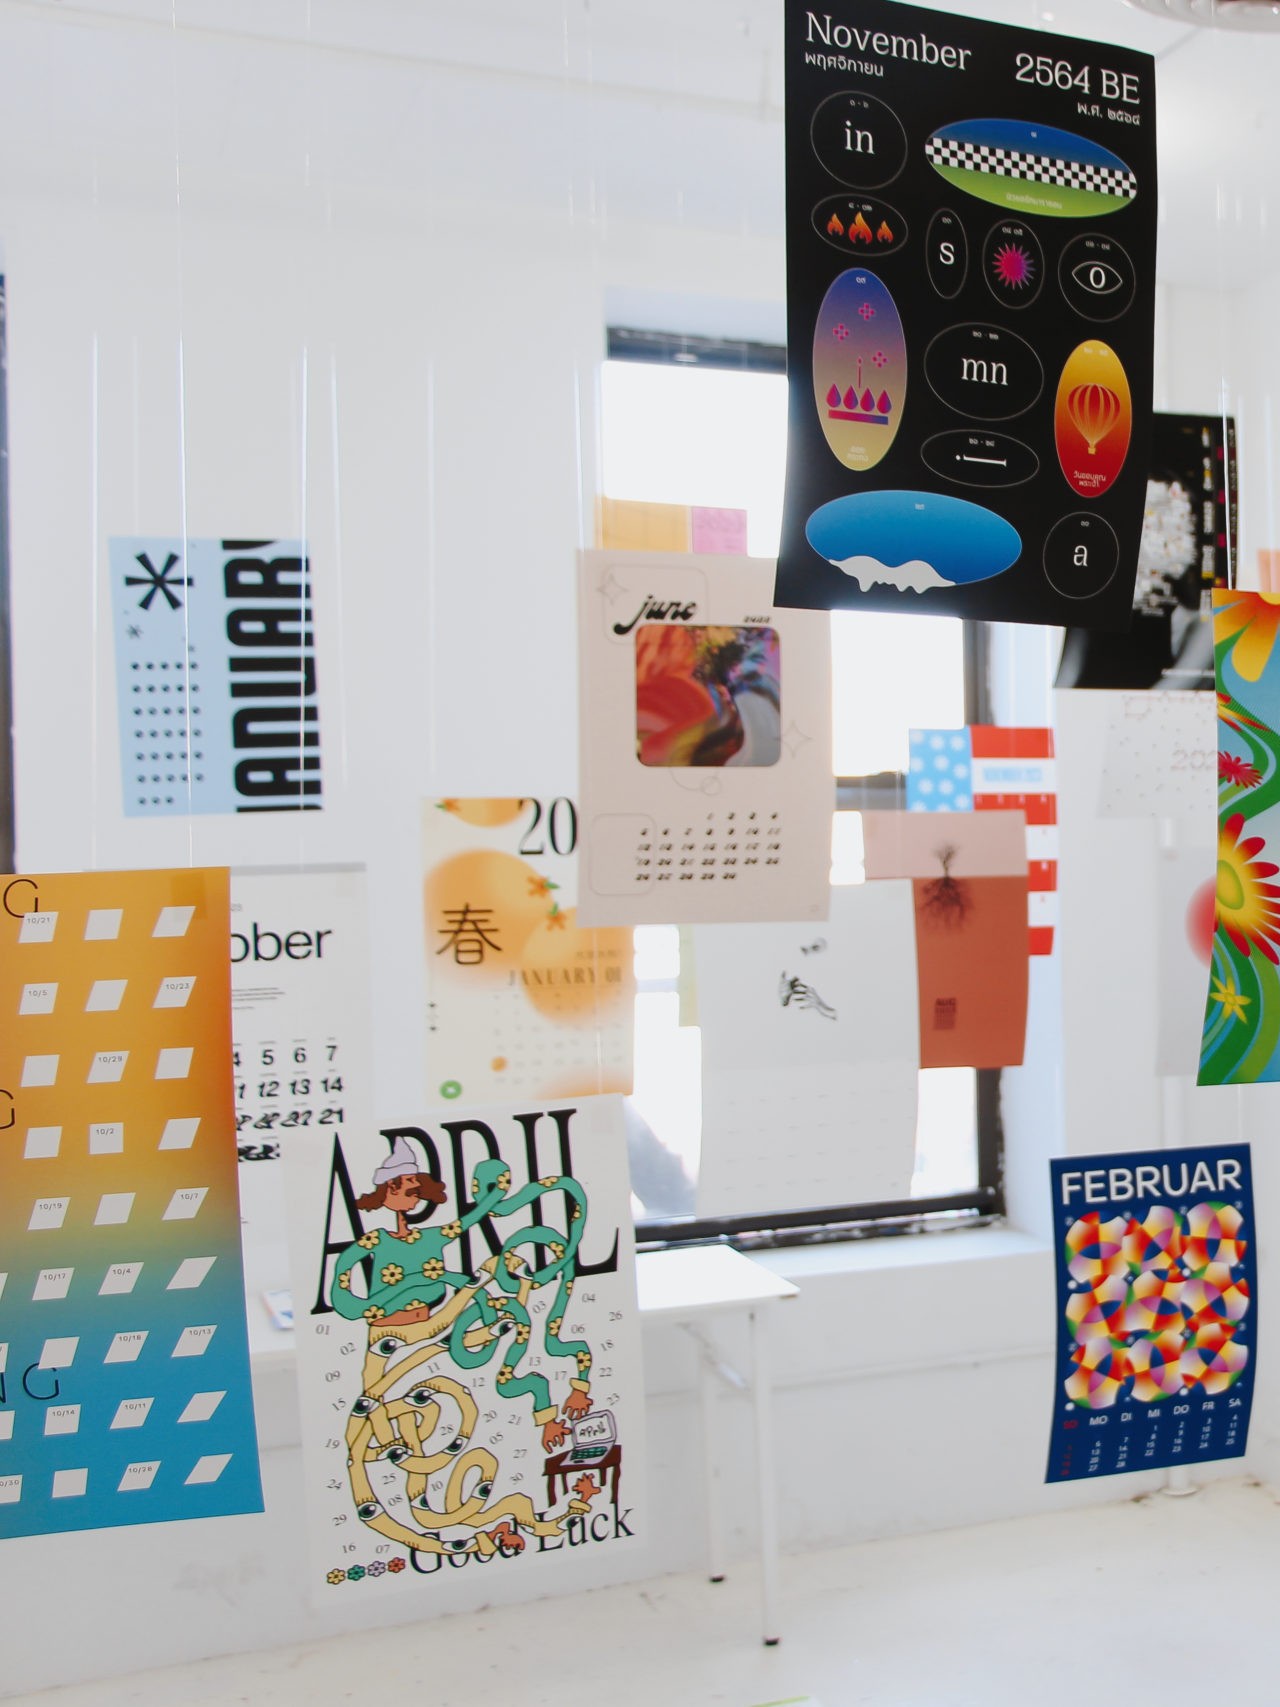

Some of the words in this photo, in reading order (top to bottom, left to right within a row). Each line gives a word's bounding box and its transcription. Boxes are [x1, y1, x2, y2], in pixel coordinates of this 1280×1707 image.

[806, 11, 971, 70] November
[1015, 53, 1090, 94] 2564
[1101, 69, 1140, 104] BE
[844, 120, 875, 155] in
[961, 357, 1008, 386] mn
[1073, 545, 1088, 567] a
[613, 595, 696, 635] june
[221, 539, 323, 813] ANUAR
[519, 797, 578, 855] 20
[26, 916, 51, 925] 10/21
[436, 902, 503, 965] 春
[261, 1049, 274, 1066] 5
[293, 1047, 307, 1063] 6
[326, 1045, 338, 1061] 7
[258, 1081, 280, 1098] 12
[290, 1078, 311, 1096] 13
[320, 1076, 344, 1093] 14
[1061, 1158, 1242, 1206] FEBRUAR
[180, 1192, 199, 1201] 10/7
[310, 1108, 619, 1316] APRIL
[112, 1268, 132, 1276] 10/4
[582, 1293, 596, 1304] 04
[315, 1323, 331, 1336] 01
[340, 1342, 357, 1357] 02
[324, 1370, 341, 1383] 09
[472, 1377, 486, 1389] 12
[124, 1402, 147, 1411] 10/11
[331, 1399, 347, 1412] 15
[1089, 1415, 1108, 1426] MO
[1121, 1412, 1133, 1422] DI
[1147, 1408, 1161, 1418] MI
[1173, 1404, 1190, 1415] DO
[1202, 1400, 1215, 1411] FR
[1228, 1398, 1242, 1408] SA
[513, 1449, 528, 1460] 27
[535, 1502, 635, 1553] Luck
